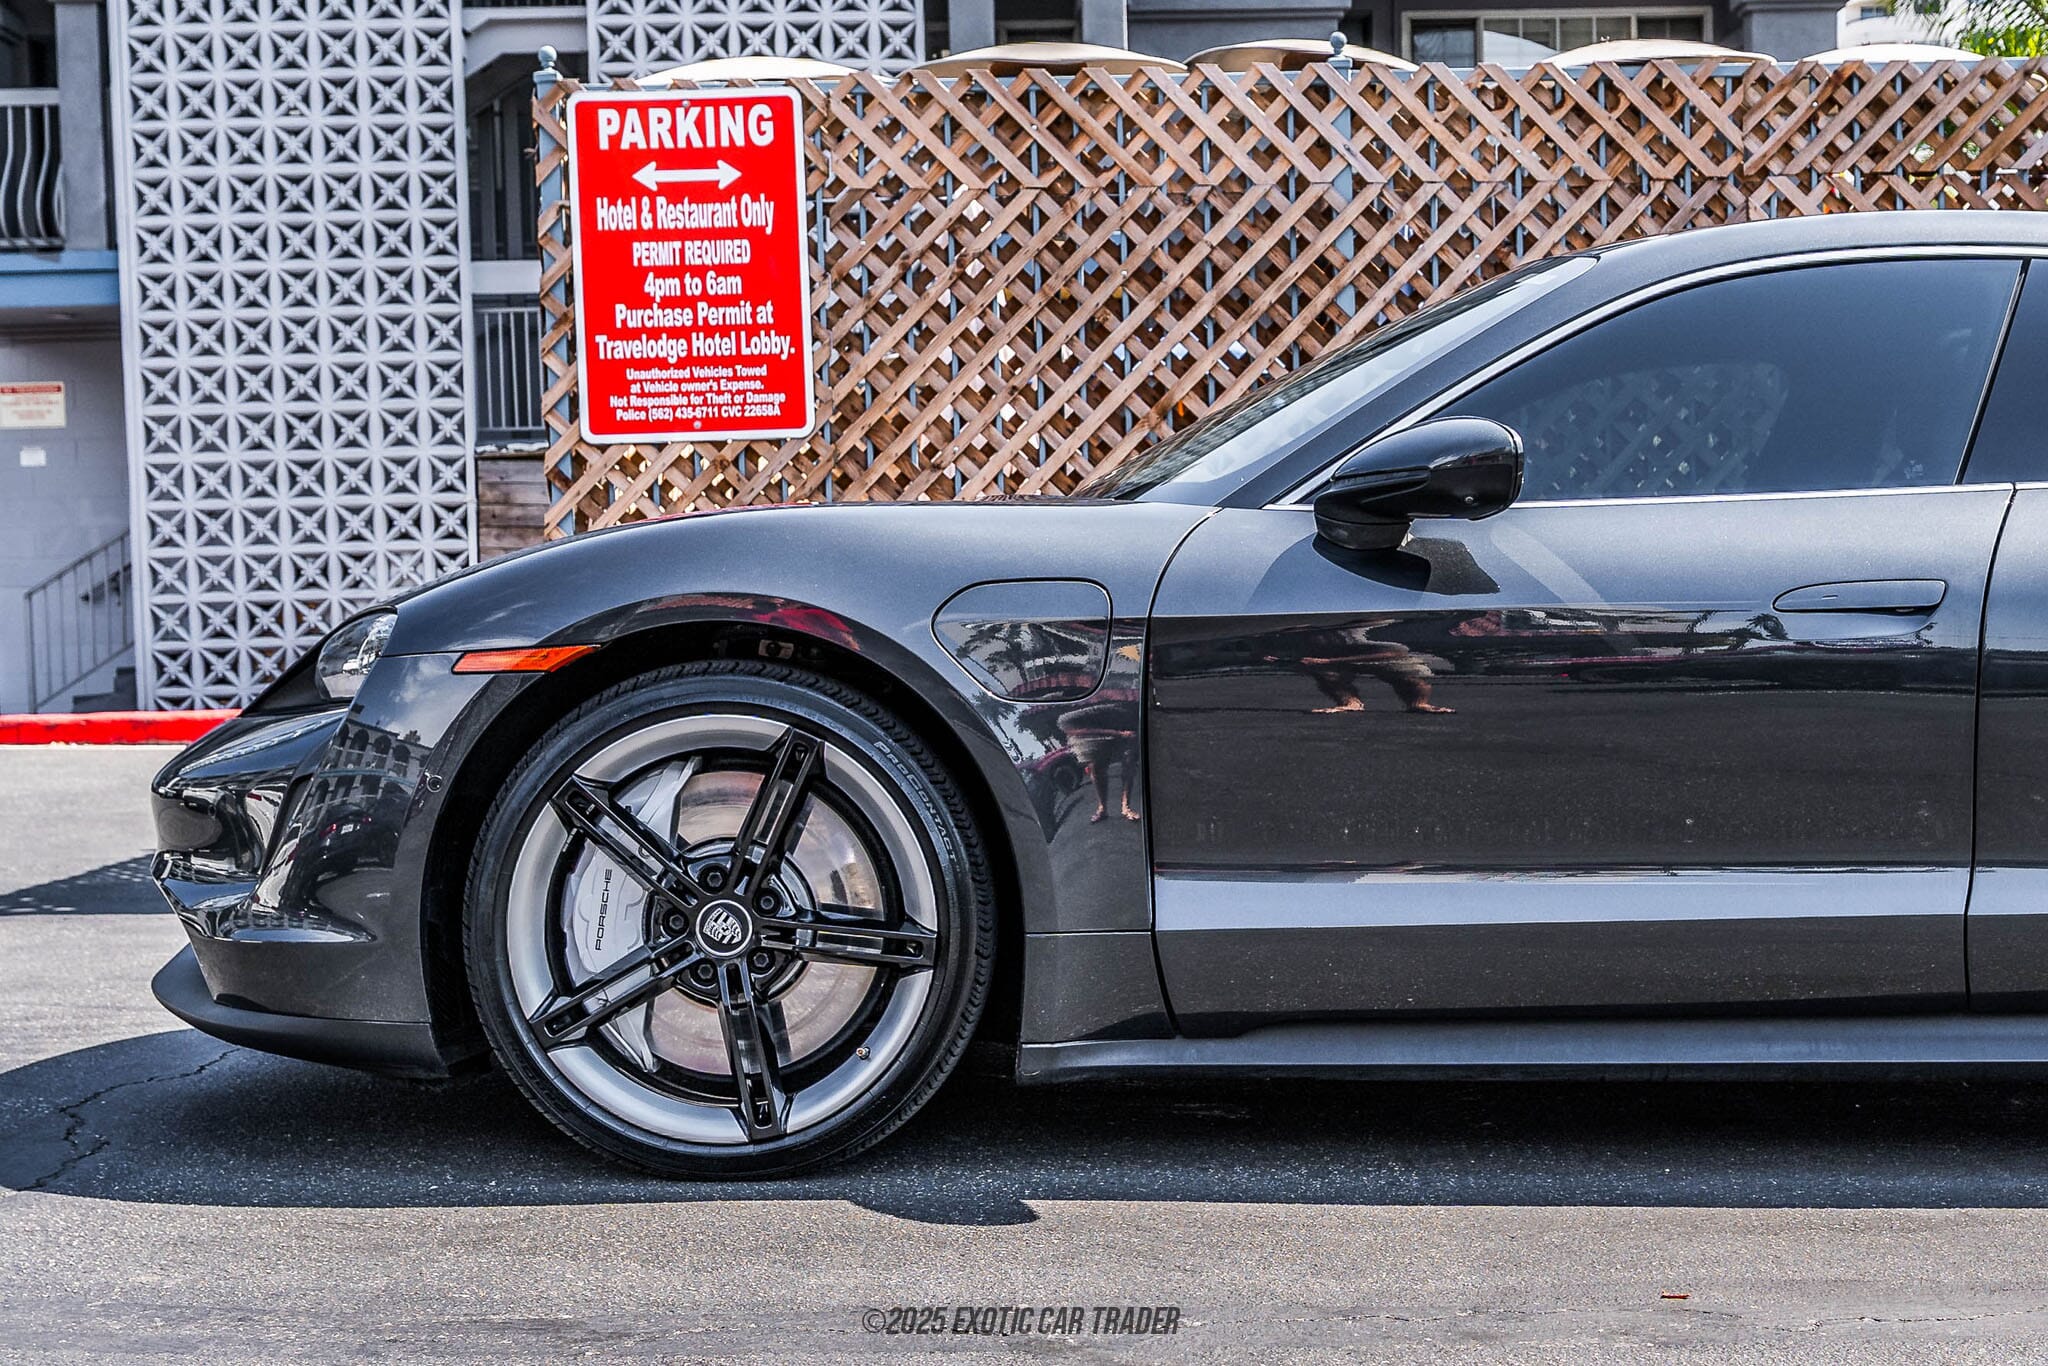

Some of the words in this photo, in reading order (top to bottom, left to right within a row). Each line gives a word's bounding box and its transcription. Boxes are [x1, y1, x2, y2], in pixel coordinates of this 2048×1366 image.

[597, 104, 775, 150] PARKING
[596, 196, 638, 231] Hotel
[640, 197, 653, 229] &
[656, 195, 738, 230] Restaurant
[740, 193, 775, 235] Only
[632, 241, 682, 267] PERMIT
[684, 239, 751, 265] REQUIRED
[643, 272, 681, 302] 4pm
[684, 273, 702, 295] to
[705, 270, 742, 295] 6am
[615, 302, 693, 329] Purchase
[697, 299, 752, 326] Permit
[756, 300, 774, 324] at
[595, 333, 687, 363] Travelodge
[691, 331, 736, 357] Hotel
[740, 330, 796, 360] Lobby.
[626, 367, 691, 380] Unauthorized
[692, 365, 734, 378] Vehicles
[735, 364, 768, 377] Towed
[630, 382, 641, 394] at
[642, 380, 679, 393] Vehicle
[680, 379, 718, 392] owner's
[720, 378, 765, 393] Expense.
[609, 395, 628, 408] Not
[629, 394, 688, 408] Responsible
[690, 393, 704, 405] for
[705, 391, 732, 405] Theft
[733, 393, 745, 404] or
[745, 391, 786, 405] Damage
[616, 408, 646, 421] Police
[648, 407, 674, 422] (562)
[675, 405, 719, 419] 435-6711
[721, 404, 742, 417] CVC
[744, 403, 781, 417] 22658A
[595, 868, 613, 951] PORSCHE
